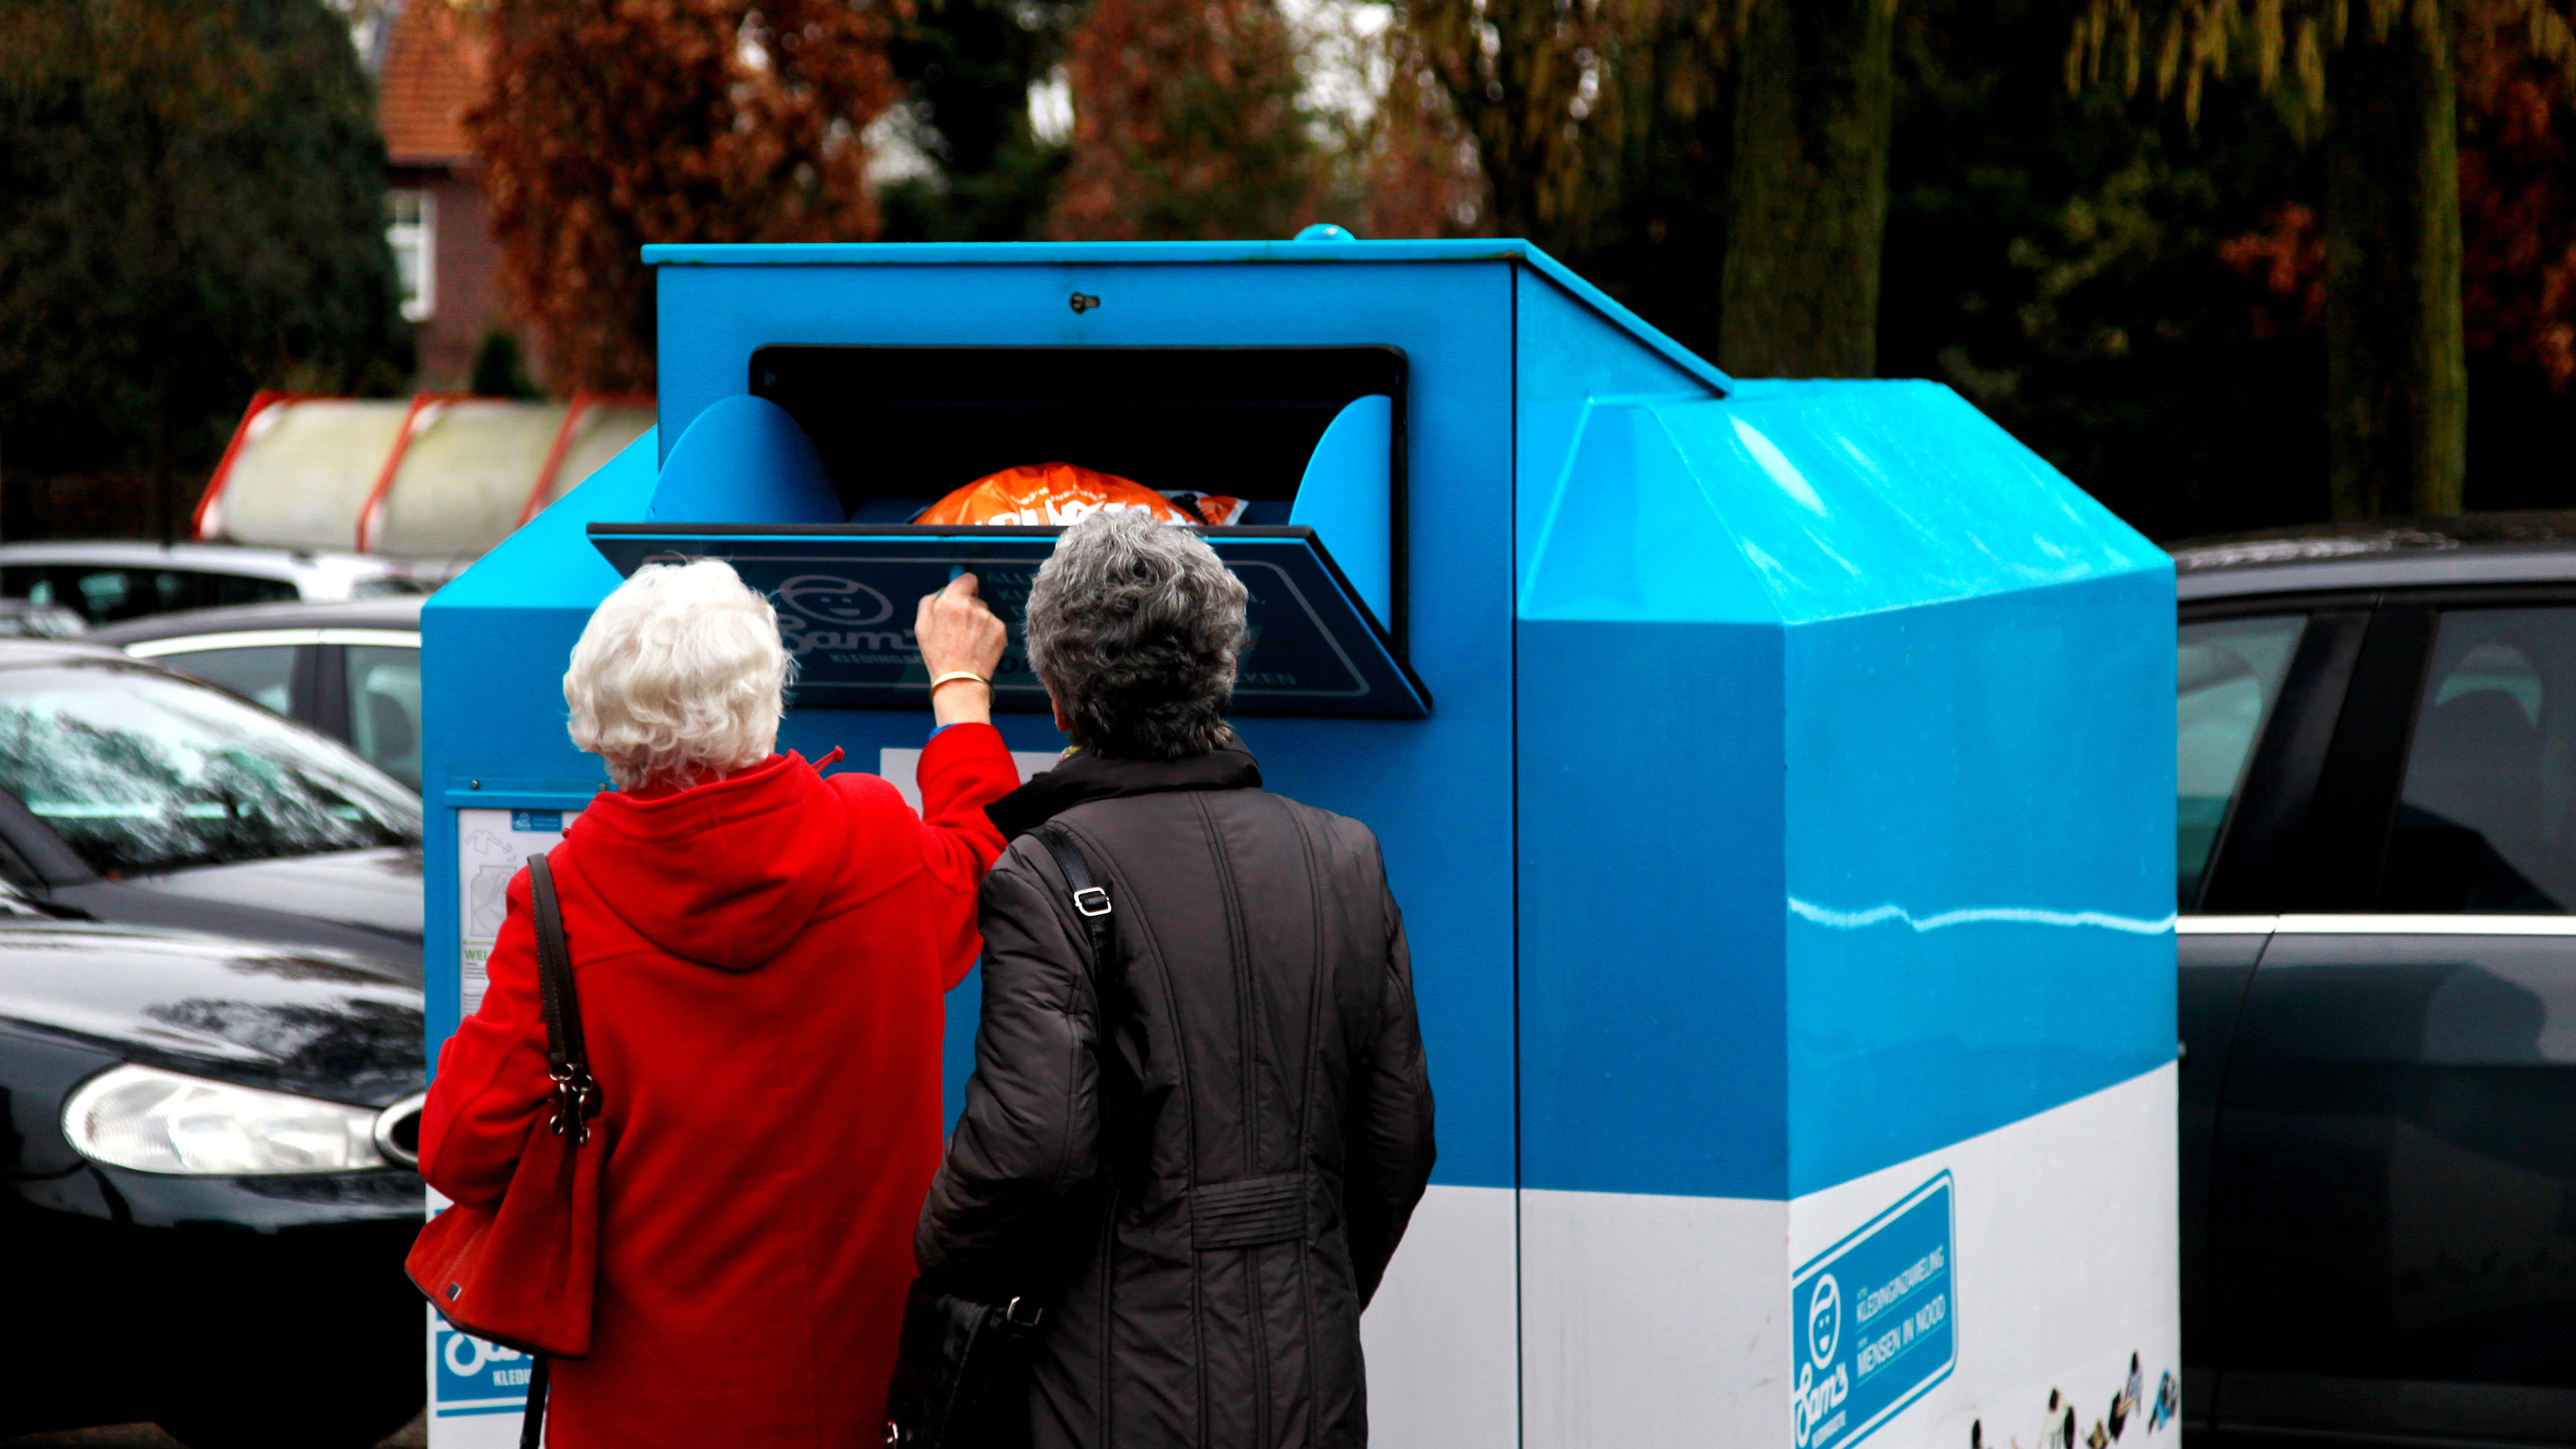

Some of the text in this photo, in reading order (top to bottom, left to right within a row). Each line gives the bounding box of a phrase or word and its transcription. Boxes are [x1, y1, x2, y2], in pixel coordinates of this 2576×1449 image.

[1857, 1293, 1945, 1379] MENSEN IN NOOD
